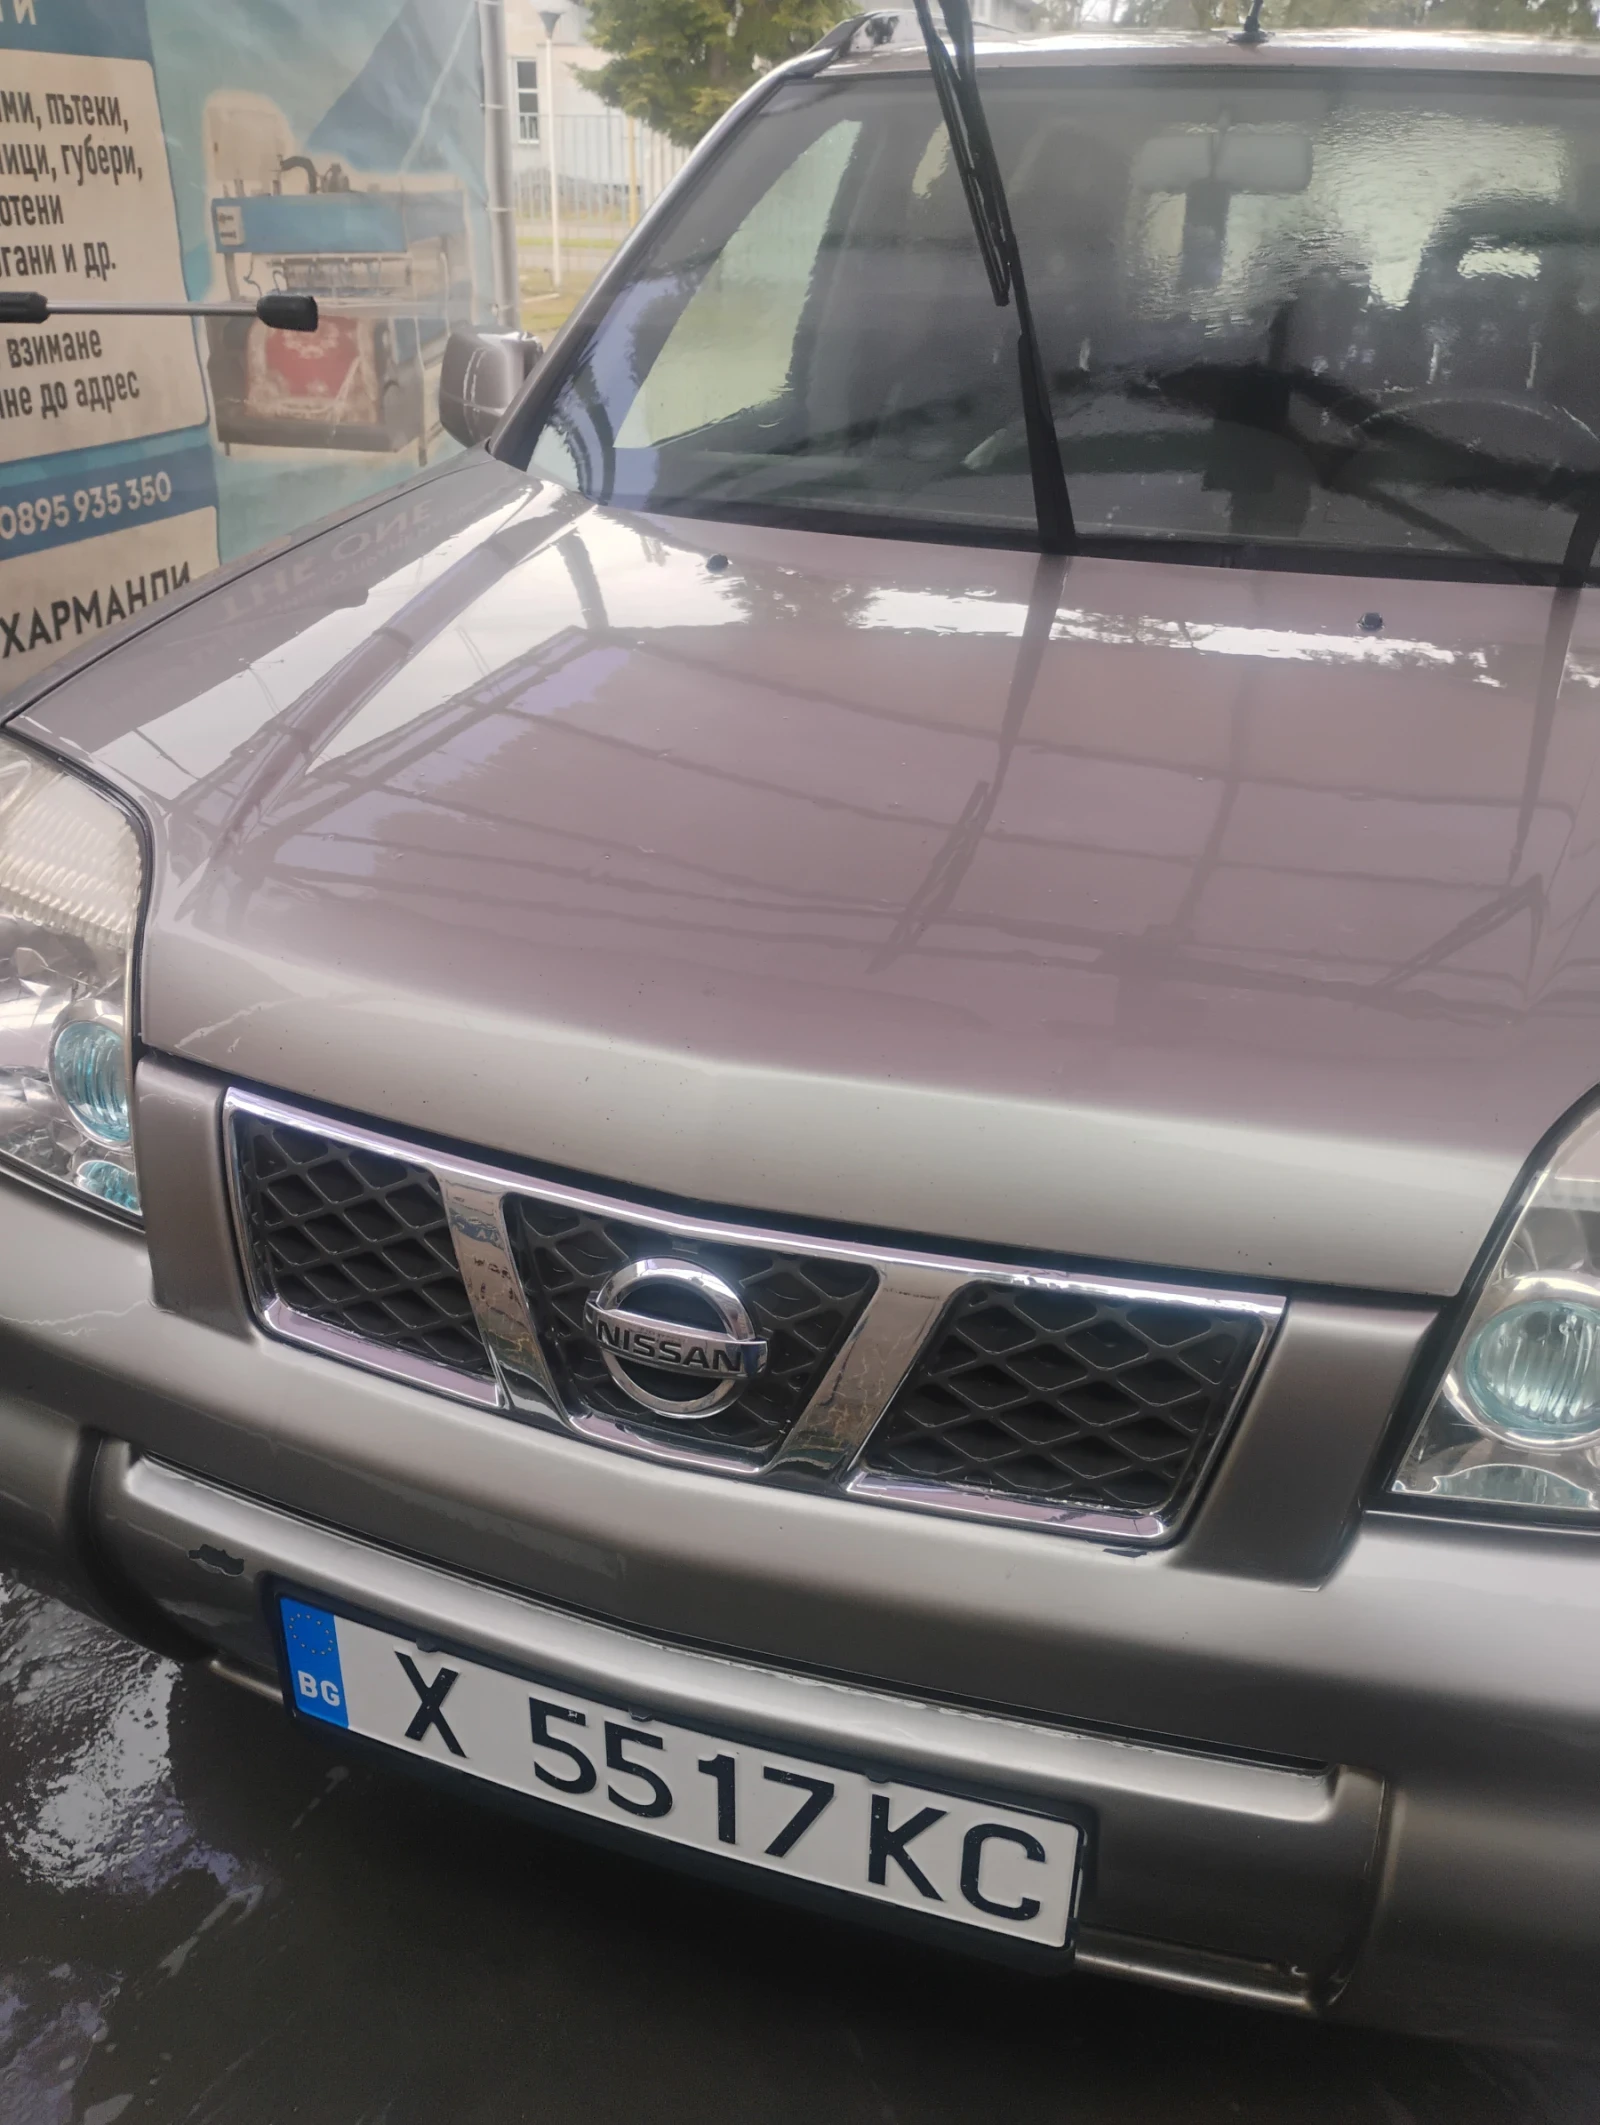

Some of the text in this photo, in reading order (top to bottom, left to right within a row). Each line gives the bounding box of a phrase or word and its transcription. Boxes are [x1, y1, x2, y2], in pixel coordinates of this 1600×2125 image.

[0, 90, 129, 134] ми, пътеки,
[0, 133, 143, 186] ици, губери,
[0, 194, 64, 227] отени
[0, 241, 116, 281] гани и др.
[6, 329, 102, 368] взимане
[0, 371, 140, 419] не до адрес
[0, 471, 172, 540] 0895 935 350
[597, 1318, 743, 1373] NISSAN
[297, 1669, 341, 1708] BG
[394, 1650, 1047, 1922] X 5517 KC
